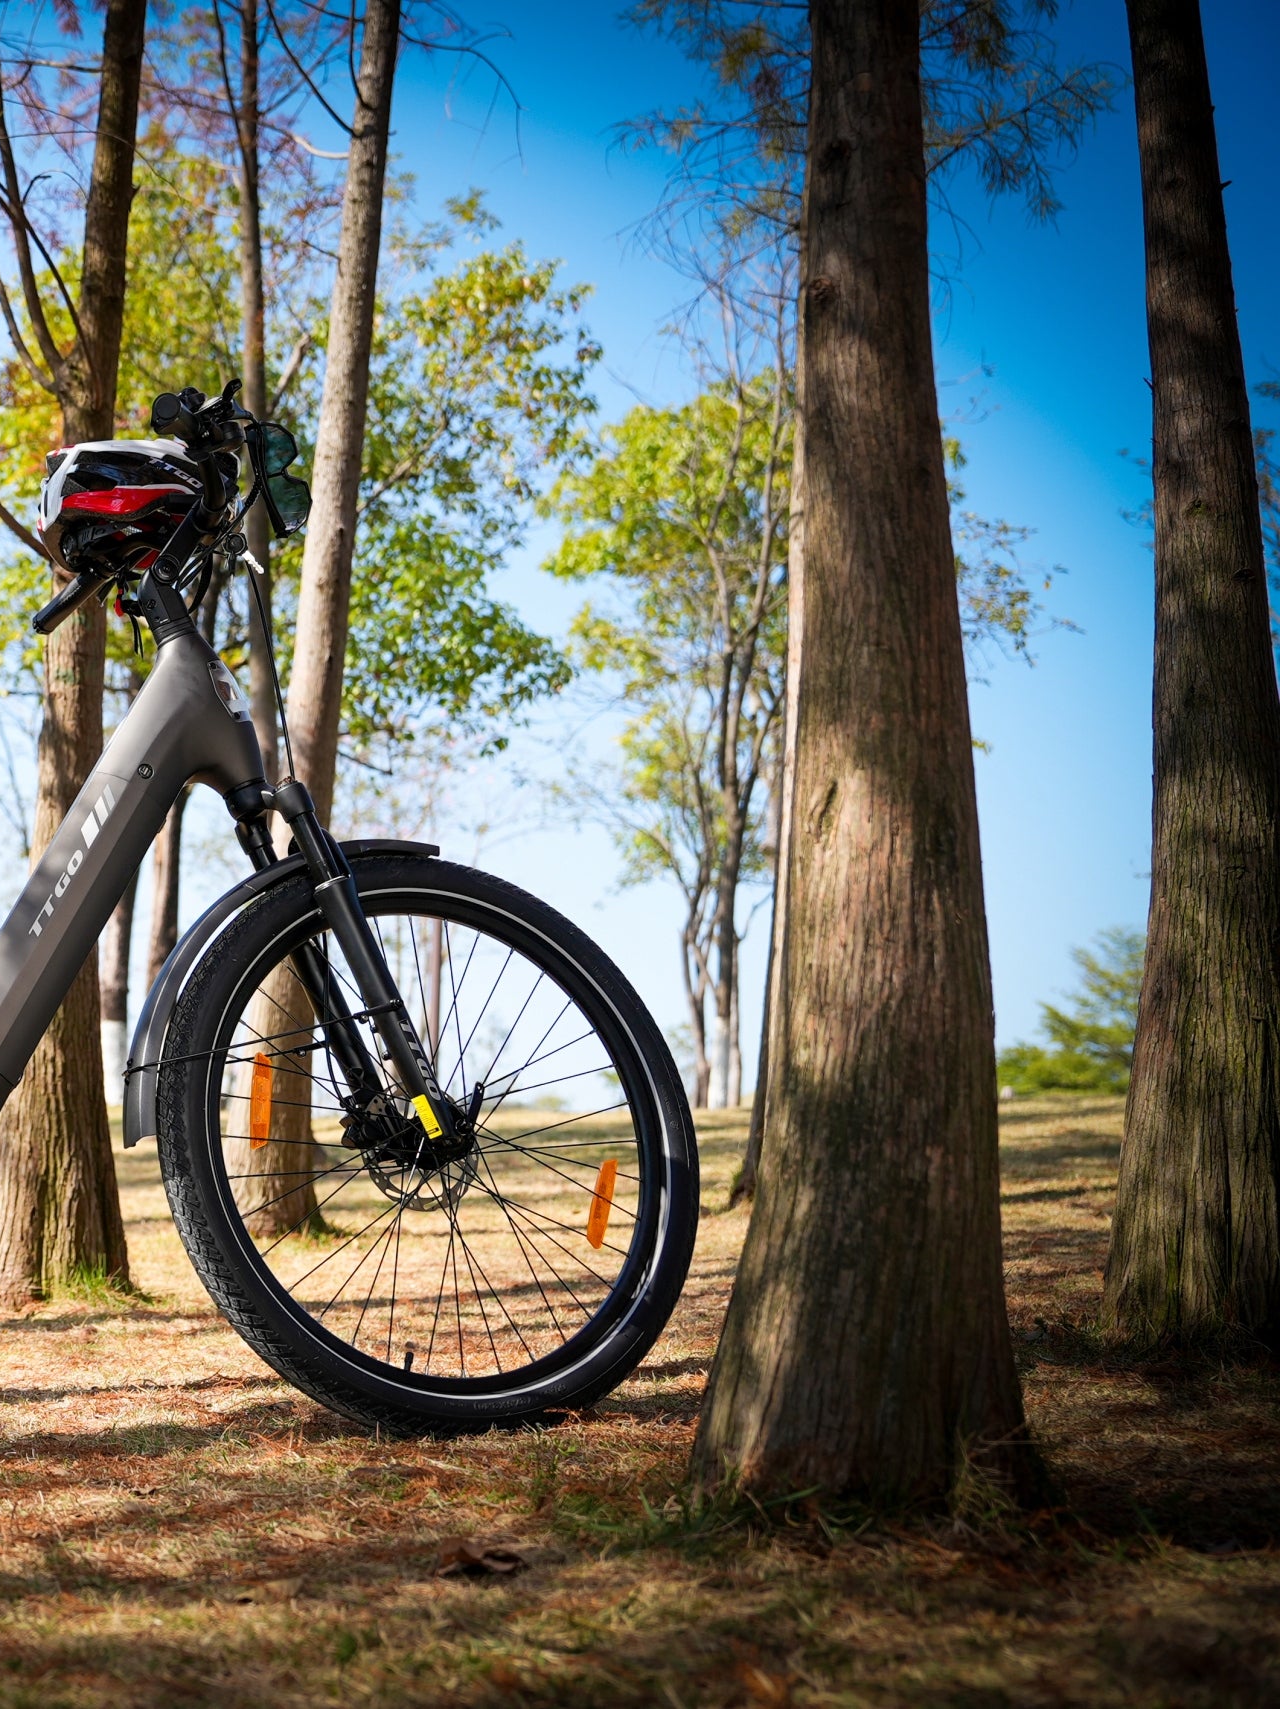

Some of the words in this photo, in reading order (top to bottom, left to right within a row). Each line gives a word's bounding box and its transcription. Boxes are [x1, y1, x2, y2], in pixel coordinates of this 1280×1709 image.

[149, 456, 204, 489] TTGO
[28, 849, 84, 938] TTGO
[399, 1019, 441, 1101] TTGO
